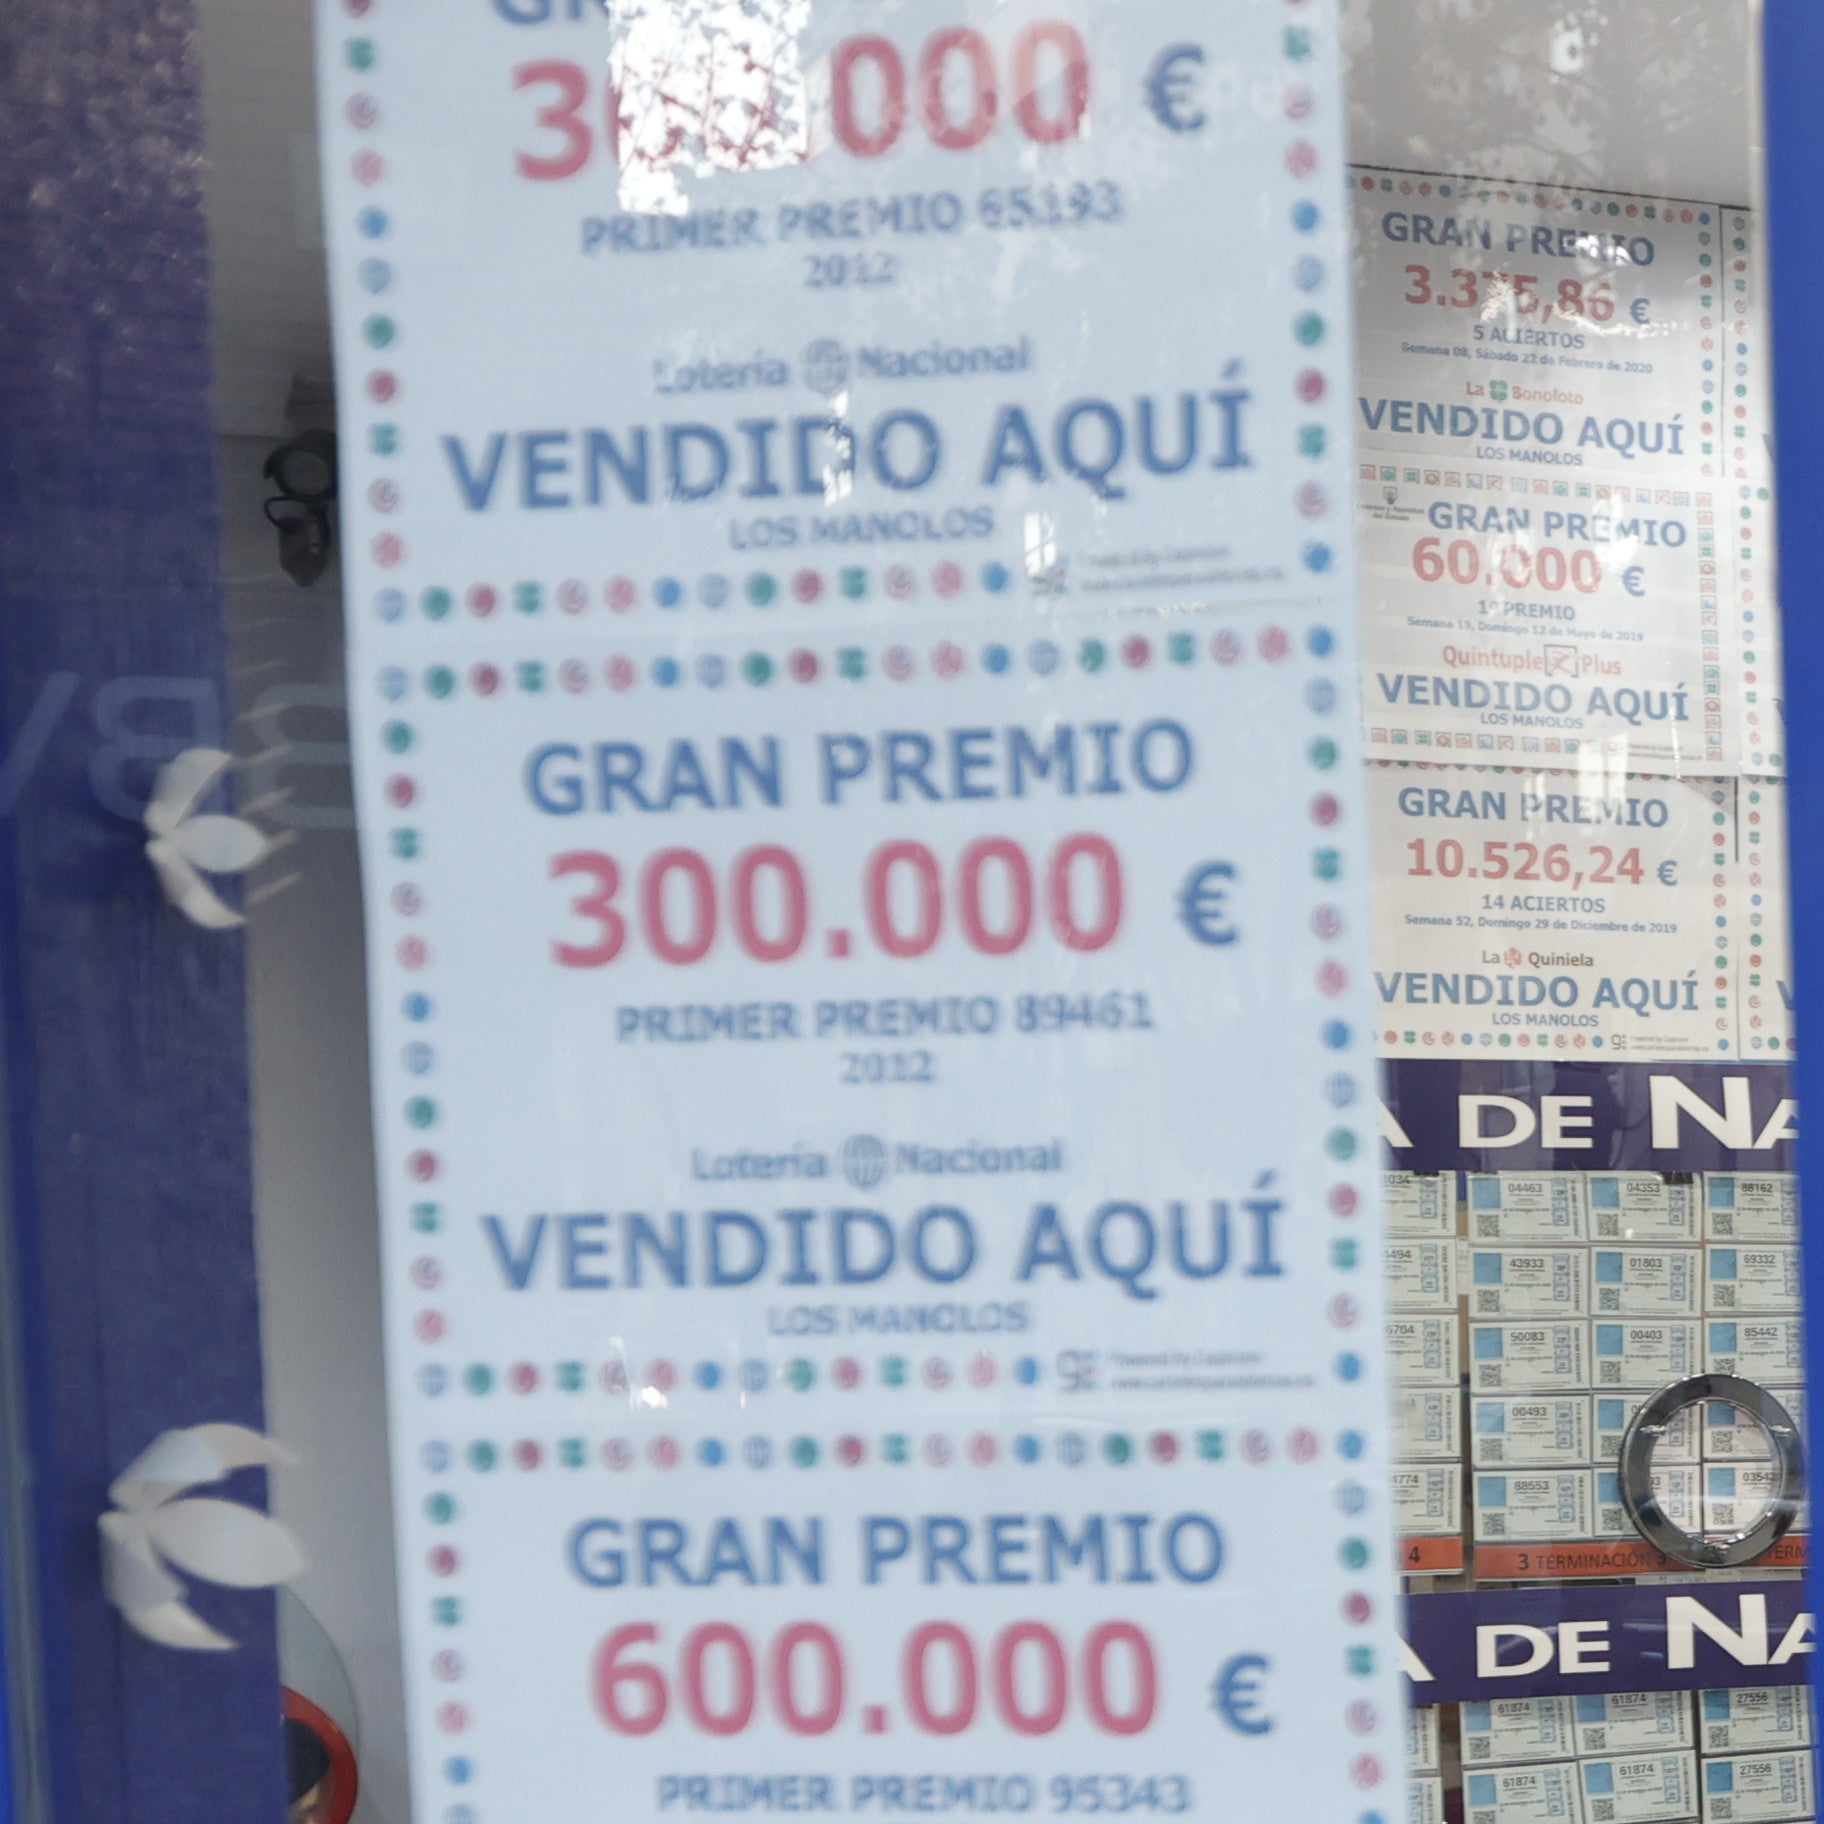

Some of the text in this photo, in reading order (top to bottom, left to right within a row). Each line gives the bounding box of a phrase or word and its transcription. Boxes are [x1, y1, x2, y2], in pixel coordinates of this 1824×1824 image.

[857, 338, 1030, 381] Nacional
[442, 359, 1254, 513] VENDIDO AQUÍ
[1358, 397, 1683, 459] VENDIDO AQUÍ
[1413, 537, 1645, 597] 60.000 €
[1443, 645, 1623, 676] Quintuple Plus
[524, 720, 1193, 815] GRAN PREMIO
[1399, 787, 1669, 828] GRAN PREMIO
[1407, 838, 1678, 890] 10.526,24 €
[549, 833, 1240, 970] 300.000 €
[1482, 895, 1605, 914] 14 ACIERTOS
[1375, 970, 1698, 1017] VENDIDO AQUÍ
[617, 991, 1154, 1044] PRIMER PREMIO 89461
[841, 1052, 934, 1084] 2012
[1458, 1094, 1594, 1150] DE
[690, 1138, 1064, 1181] Lotería Nacional
[1508, 1183, 1542, 1193] 04463
[481, 1169, 1285, 1300] VENDIDO AQUÍ
[1509, 1258, 1544, 1268] 43933
[1630, 1258, 1662, 1268] 01803
[767, 1300, 1031, 1336] LOS MANOLOS
[1510, 1332, 1545, 1341] 50083
[568, 1513, 1224, 1587] GRAN PREMIO
[1518, 1553, 1529, 1571] 3
[1476, 1621, 1611, 1678] DE
[591, 1620, 1276, 1738] 600.000 €
[1739, 1763, 1772, 1775] 27556
[658, 1776, 1192, 1814] PRIMER PREMIO 95343
